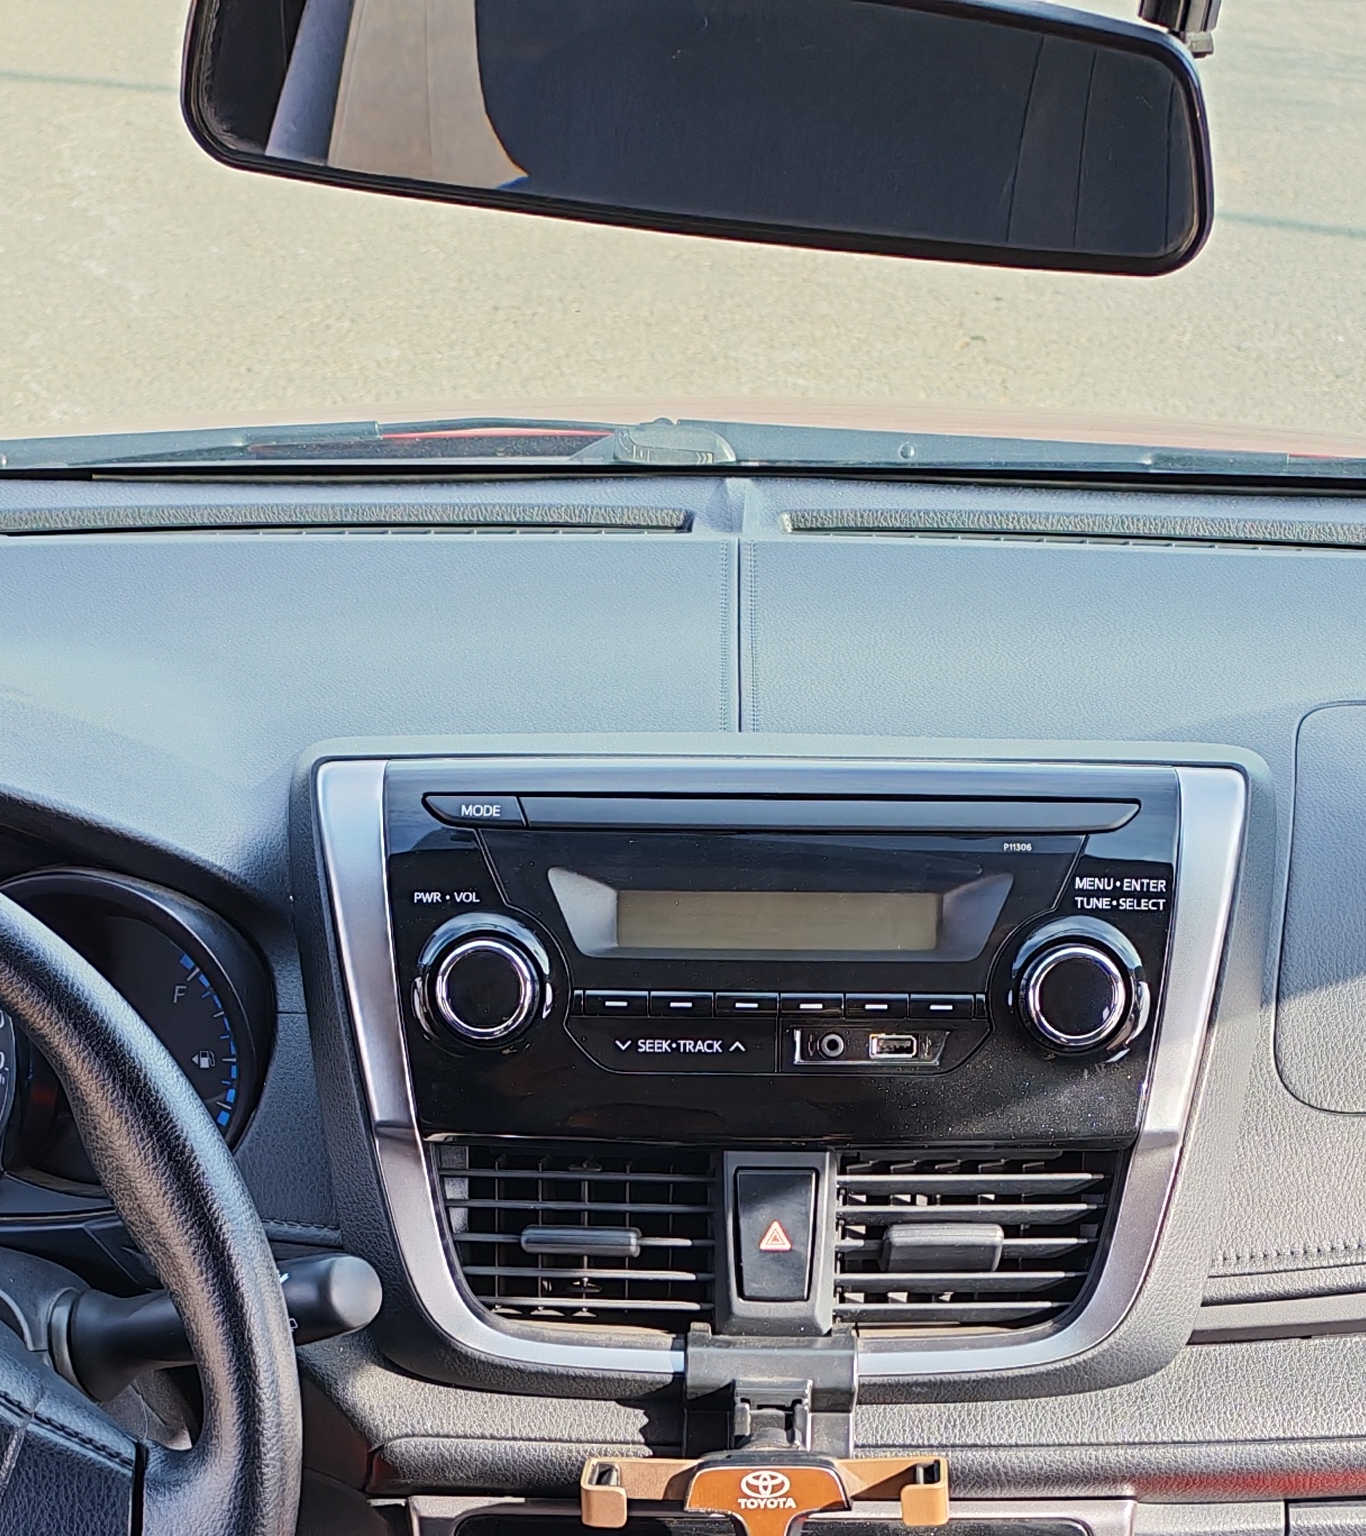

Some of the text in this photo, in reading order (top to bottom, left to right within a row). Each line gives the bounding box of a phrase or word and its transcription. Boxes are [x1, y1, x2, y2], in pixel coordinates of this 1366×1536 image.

[461, 804, 502, 817] MODE
[1003, 843, 1032, 851] P11306
[173, 986, 187, 1004] F
[738, 1498, 796, 1509] TOYOTA
